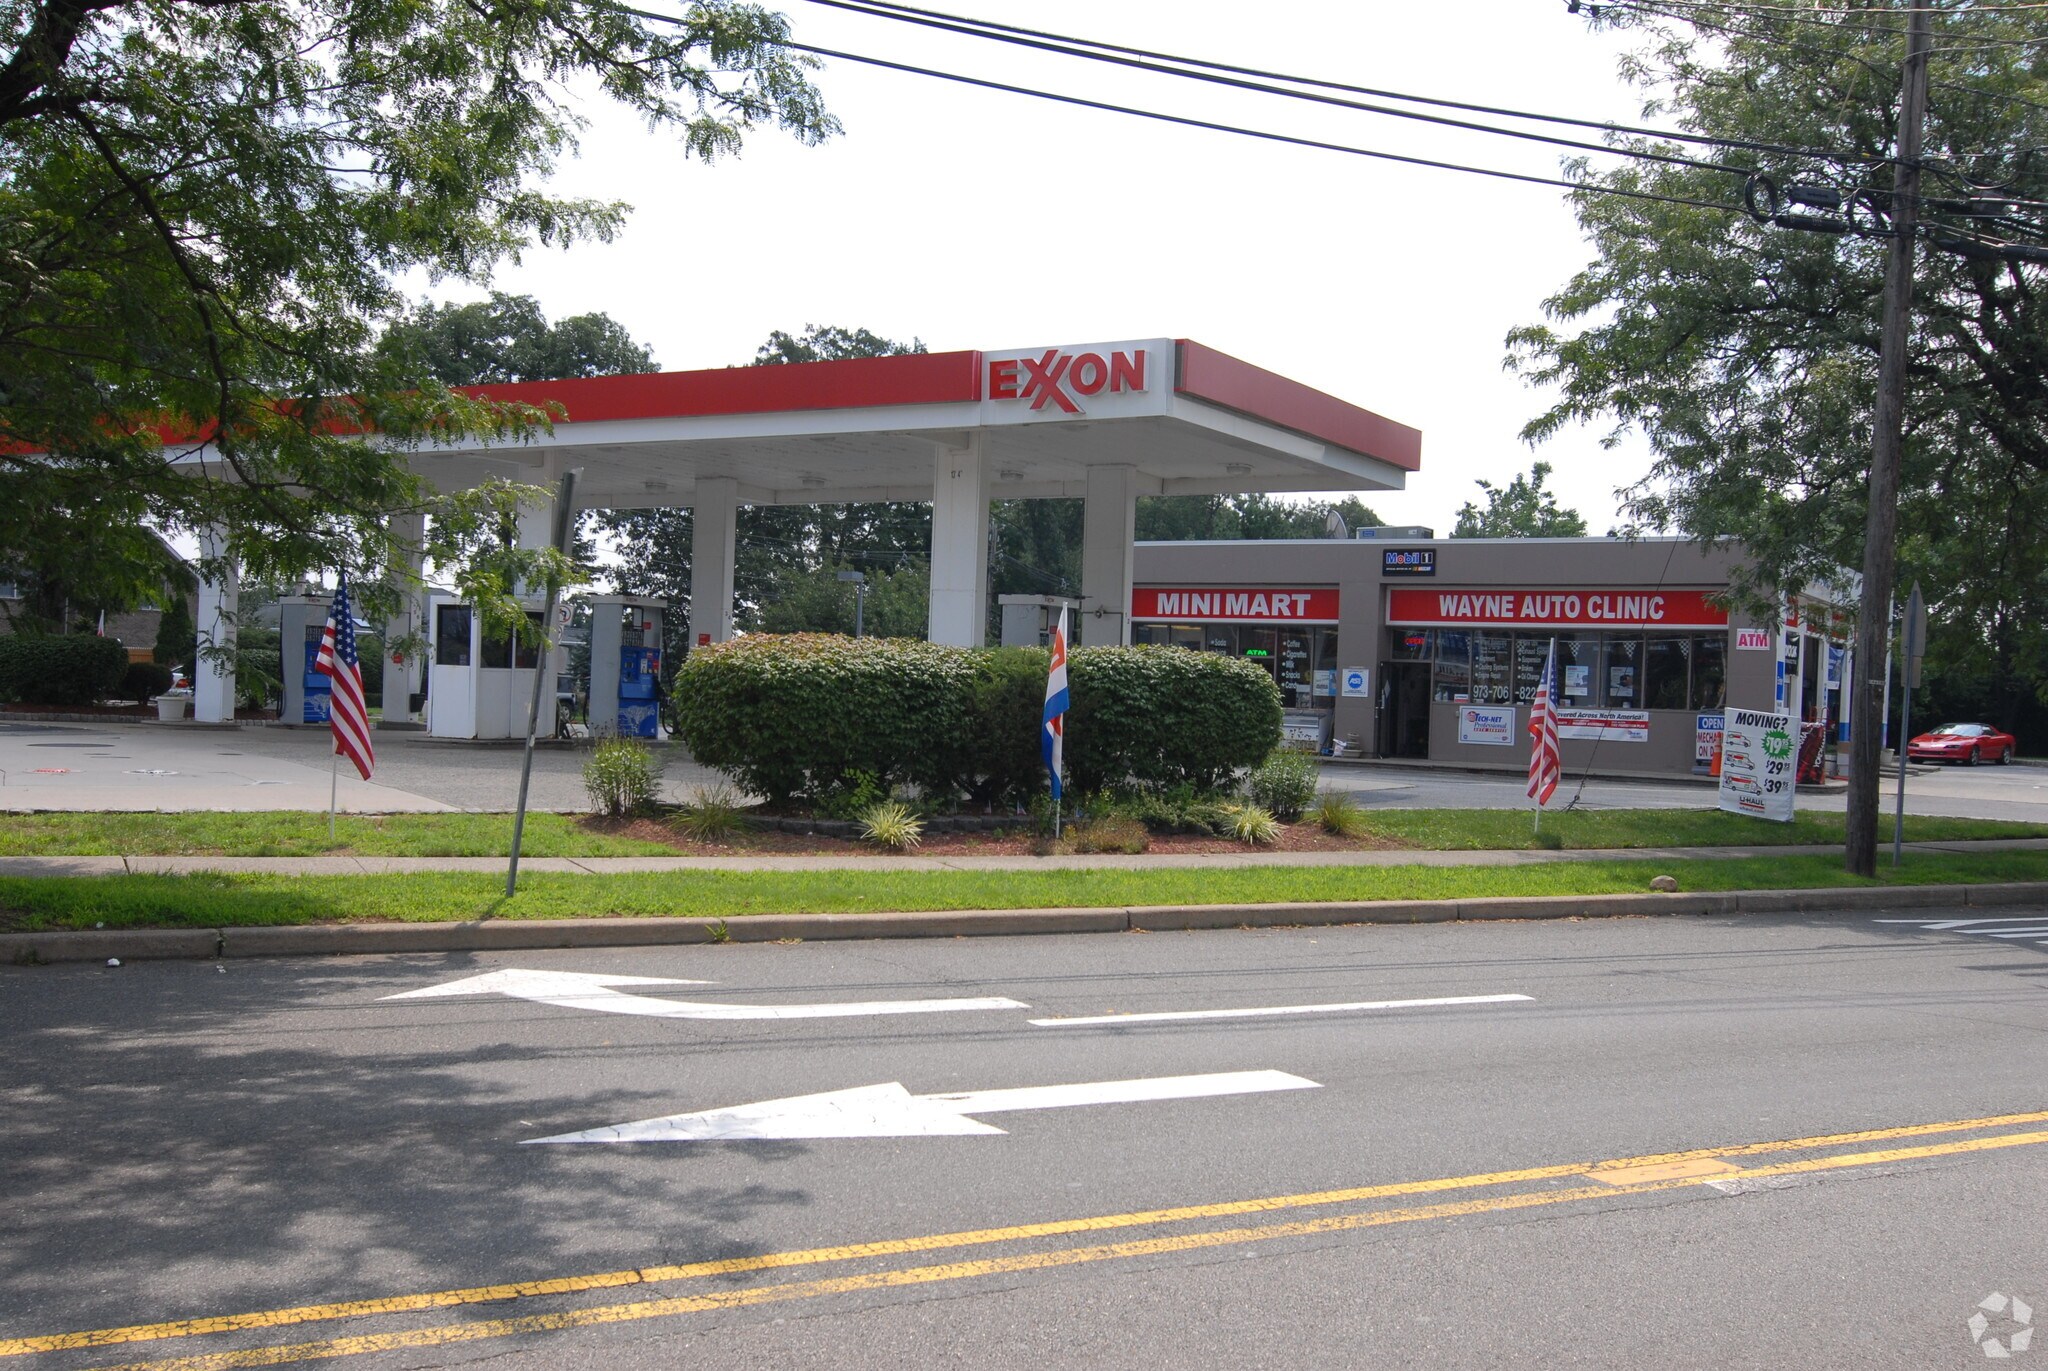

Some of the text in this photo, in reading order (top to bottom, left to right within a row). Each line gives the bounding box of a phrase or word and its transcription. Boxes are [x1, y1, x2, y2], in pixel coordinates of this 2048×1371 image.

[989, 350, 1146, 413] EXXON
[1386, 552, 1420, 565] Mobil
[1157, 593, 1311, 616] MINI MART
[1439, 595, 1665, 620] WAYNE AUTO CLINIC
[1214, 639, 1227, 647] Soda
[1286, 640, 1301, 649] Coffee
[1738, 633, 1768, 648] ATM
[1246, 649, 1267, 657] ATM
[1286, 650, 1308, 660] Cigarettes
[1285, 671, 1301, 680] Snacks
[1285, 681, 1297, 689] Cand
[1473, 685, 1509, 699] 973-706
[1701, 718, 1724, 729] OPEN
[1735, 712, 1789, 730] MOVING?
[1698, 746, 1709, 757] ON
